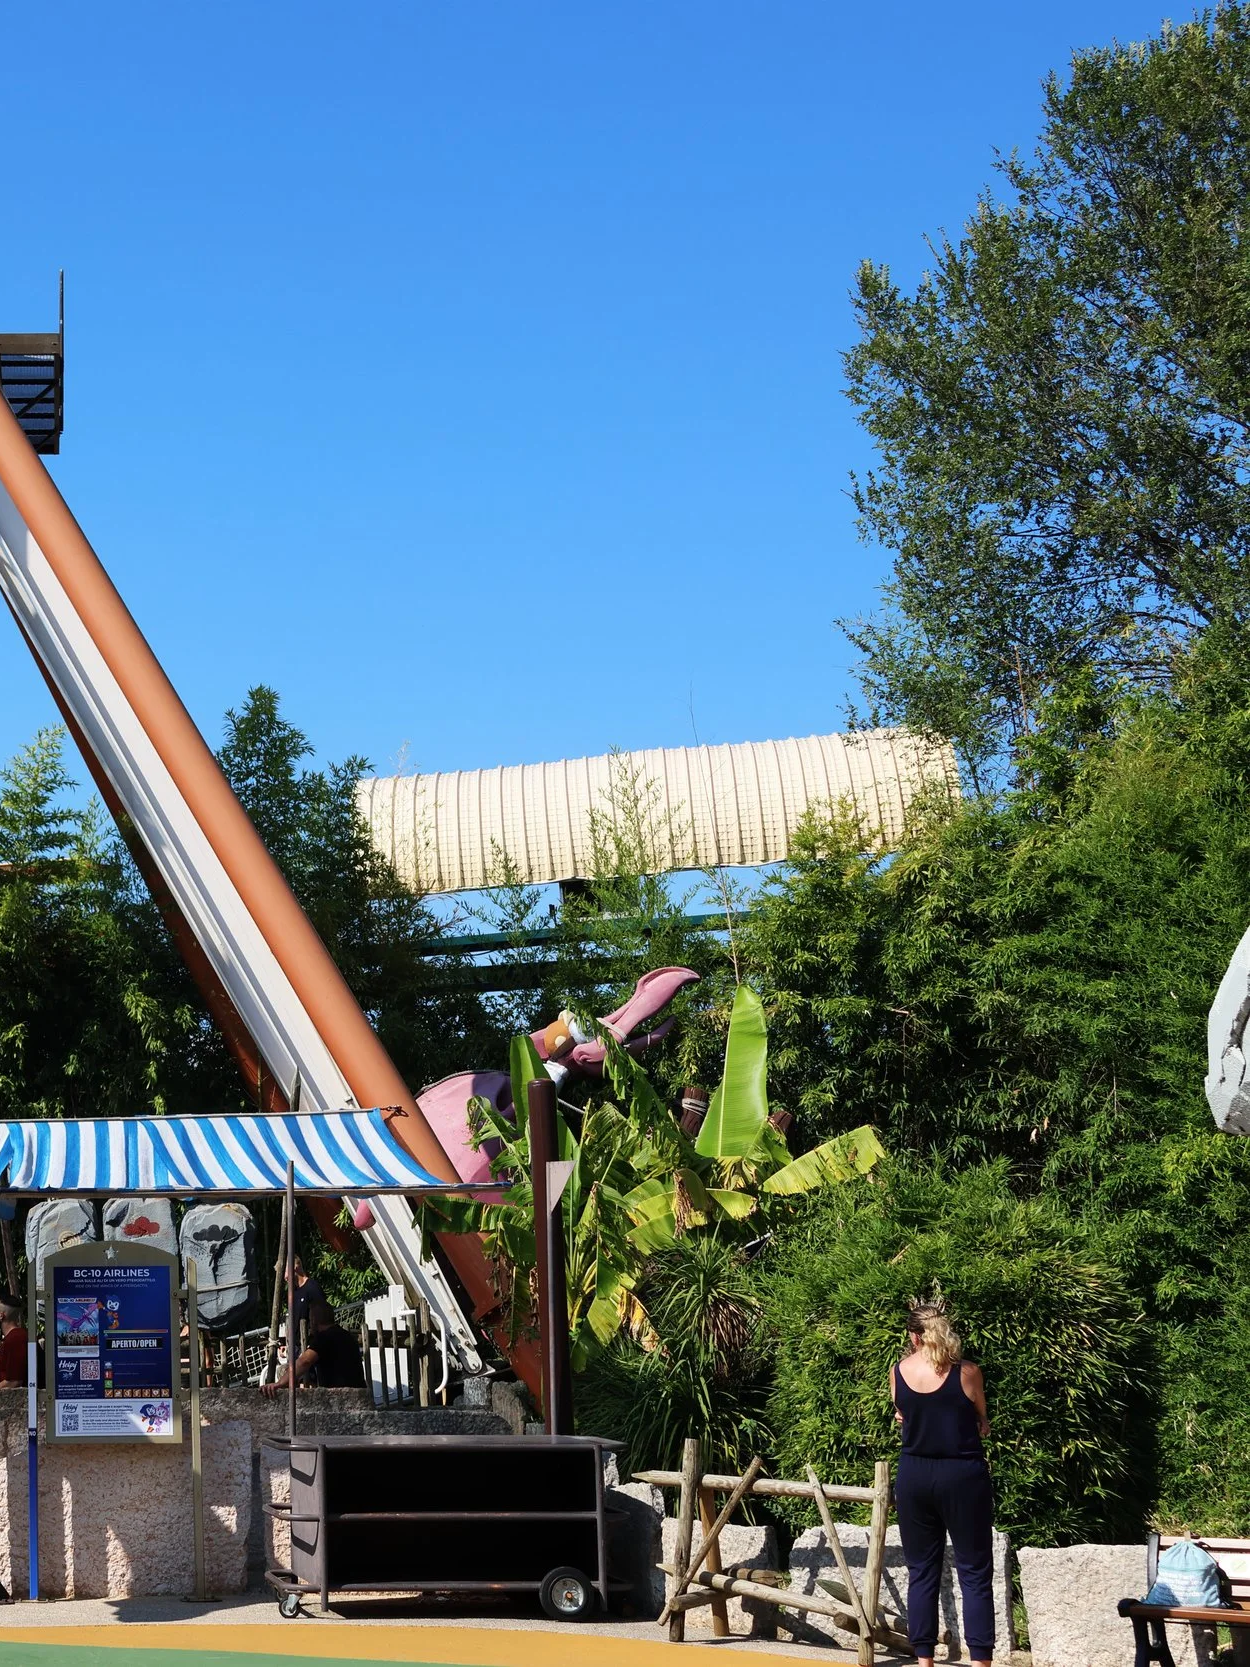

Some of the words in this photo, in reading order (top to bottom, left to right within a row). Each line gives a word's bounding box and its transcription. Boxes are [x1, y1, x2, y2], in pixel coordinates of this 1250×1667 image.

[73, 1269, 101, 1278] BC-10
[103, 1268, 150, 1277] AIRLINES
[111, 1340, 157, 1349] APERTO/OPEN
